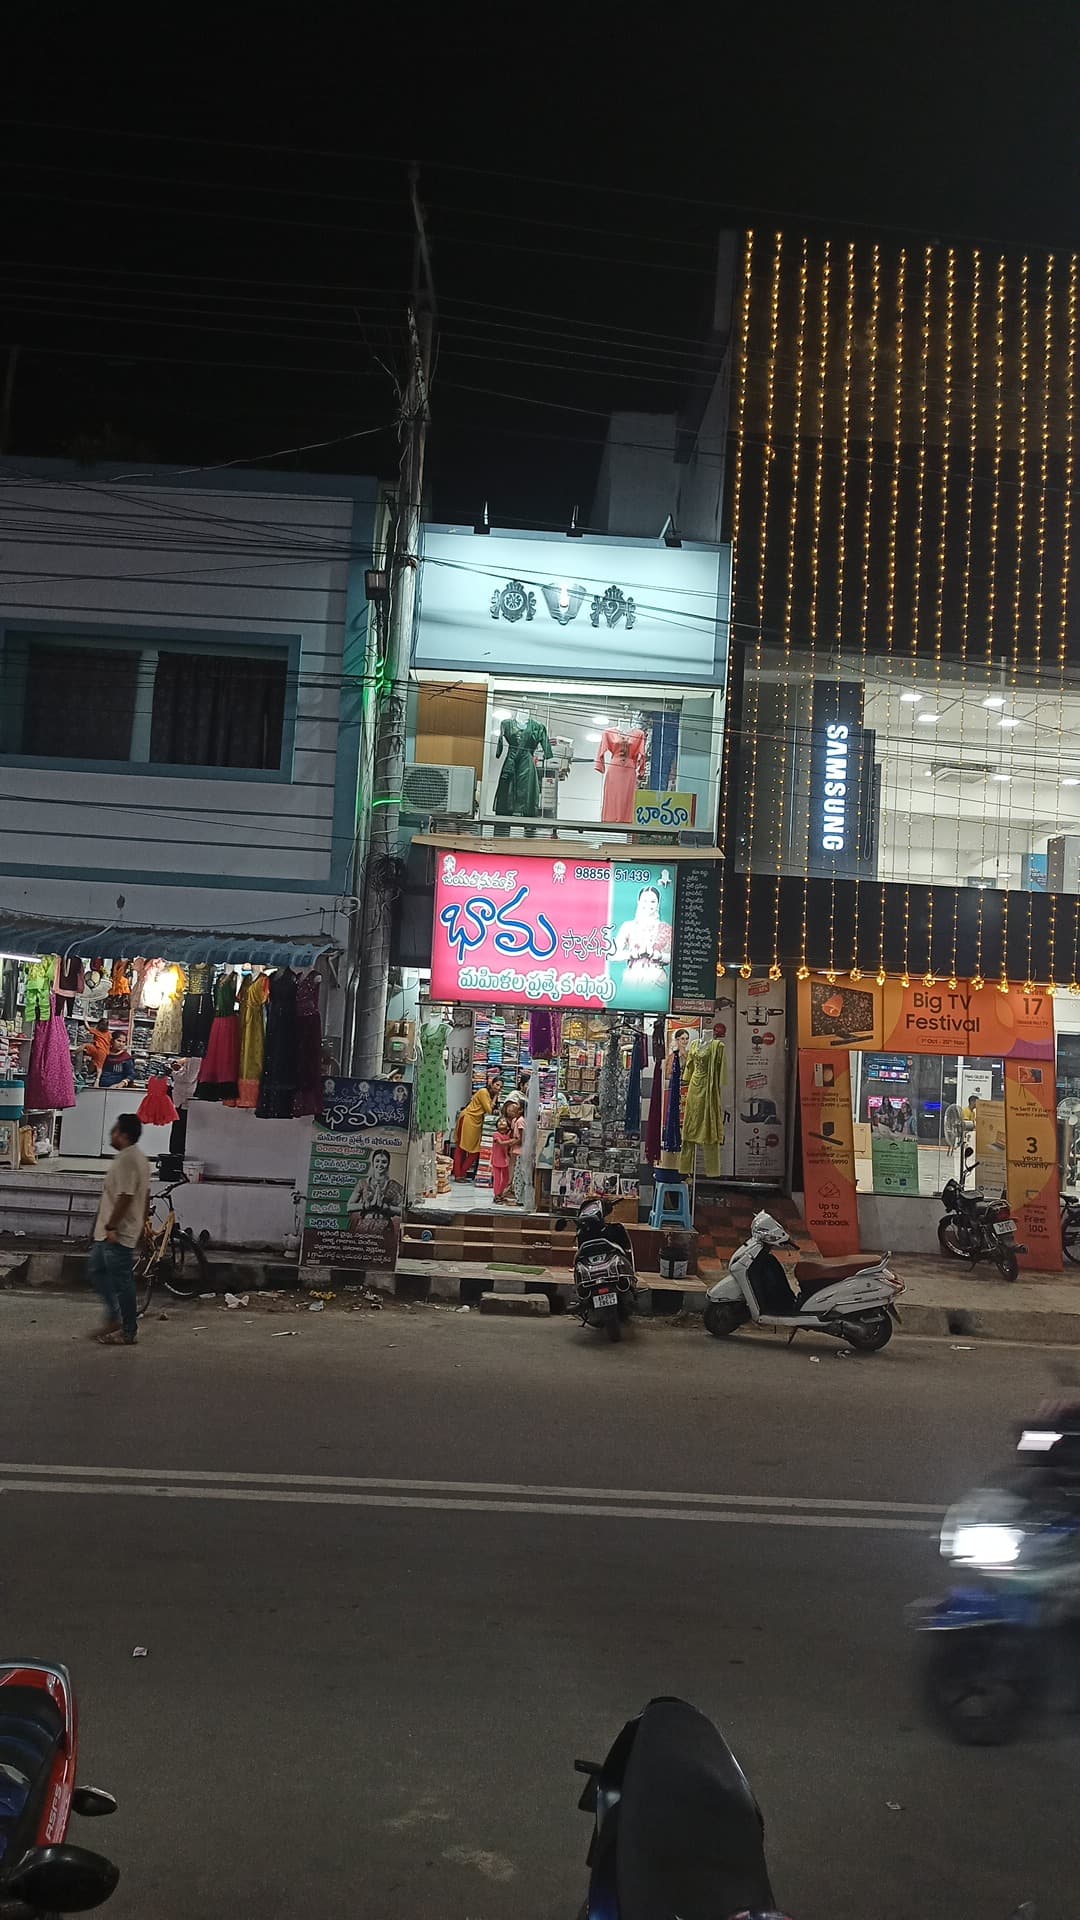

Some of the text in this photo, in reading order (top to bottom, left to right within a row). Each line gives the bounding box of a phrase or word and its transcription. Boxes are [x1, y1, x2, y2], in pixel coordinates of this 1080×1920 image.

[822, 724, 849, 851] SAMSUNG
[574, 867, 651, 882] 98856 51439
[458, 966, 526, 992] మహిళల
[913, 992, 972, 1014] Big TV
[1023, 998, 1043, 1015] 17
[905, 1014, 980, 1033] Festival
[1026, 1137, 1038, 1154] 3
[1013, 1161, 1048, 1170] warranty
[819, 1203, 830, 1211] Up
[822, 1211, 839, 1219] 20%
